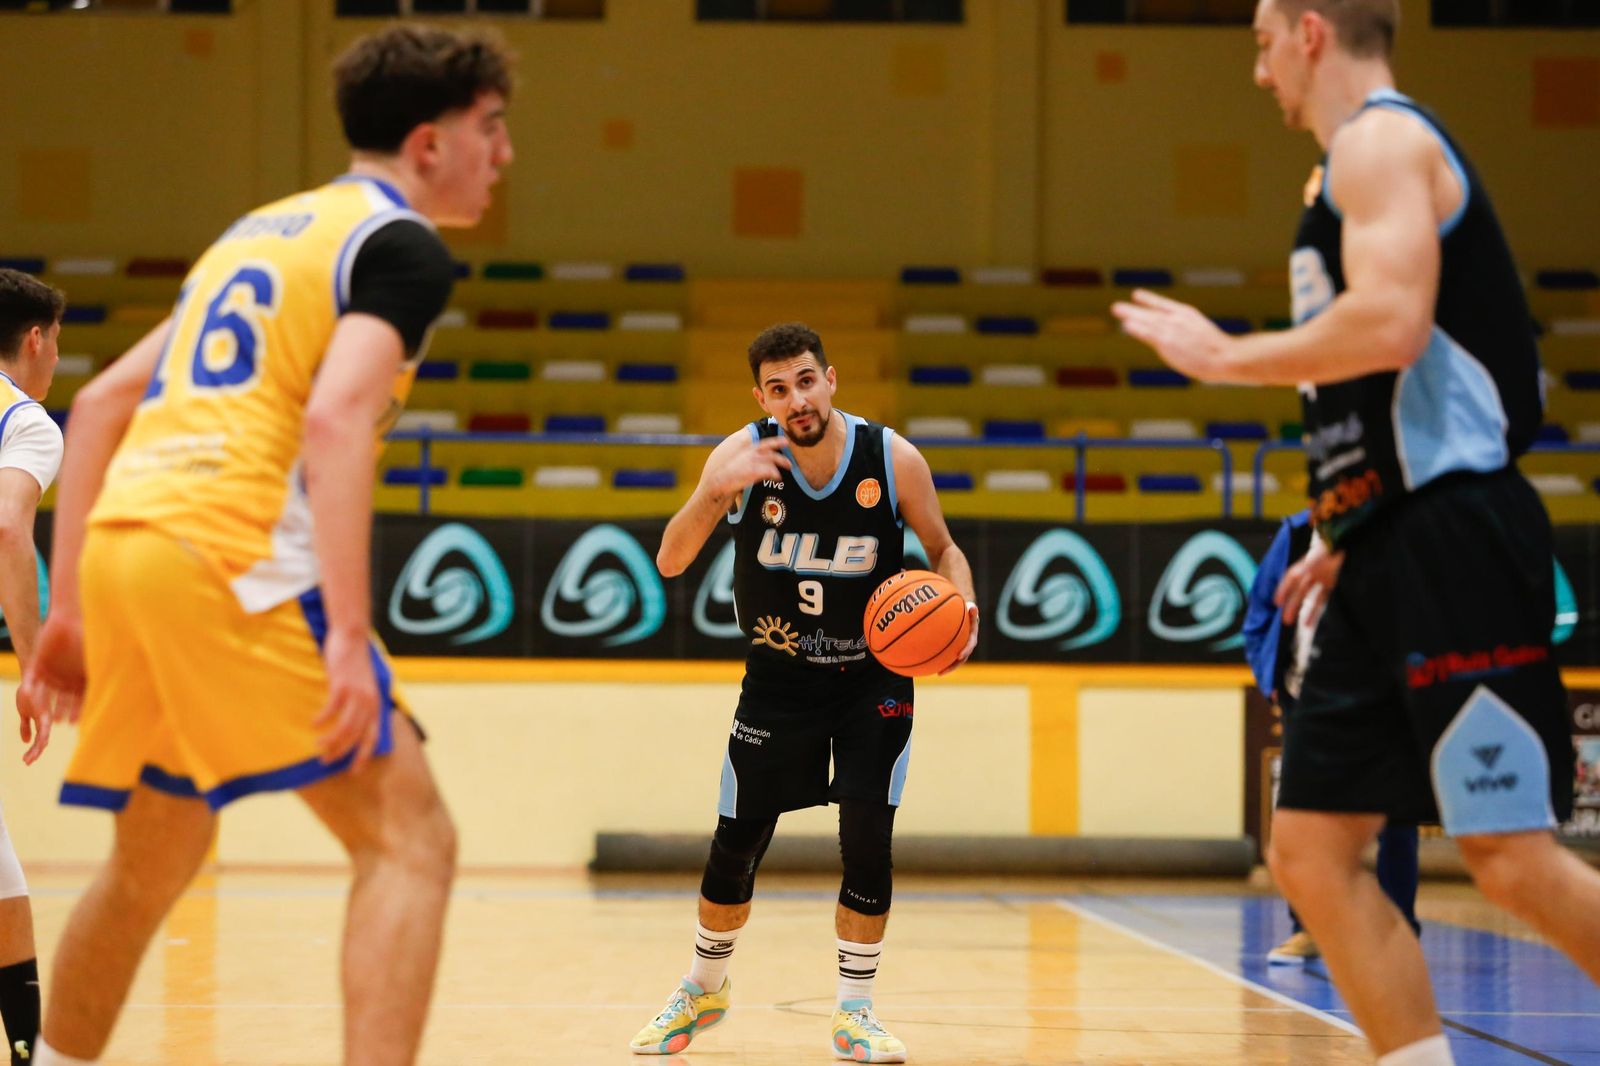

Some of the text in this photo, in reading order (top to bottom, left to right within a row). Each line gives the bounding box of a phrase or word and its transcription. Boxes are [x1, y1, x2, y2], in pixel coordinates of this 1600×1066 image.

[142, 262, 279, 407] 16
[763, 479, 785, 490] vive
[757, 528, 879, 577] ULB
[798, 580, 823, 616] 9
[876, 584, 939, 632] Wilson
[737, 732, 763, 745] de Cádiz
[739, 722, 771, 738] Diputación
[847, 888, 878, 904] TARMAK
